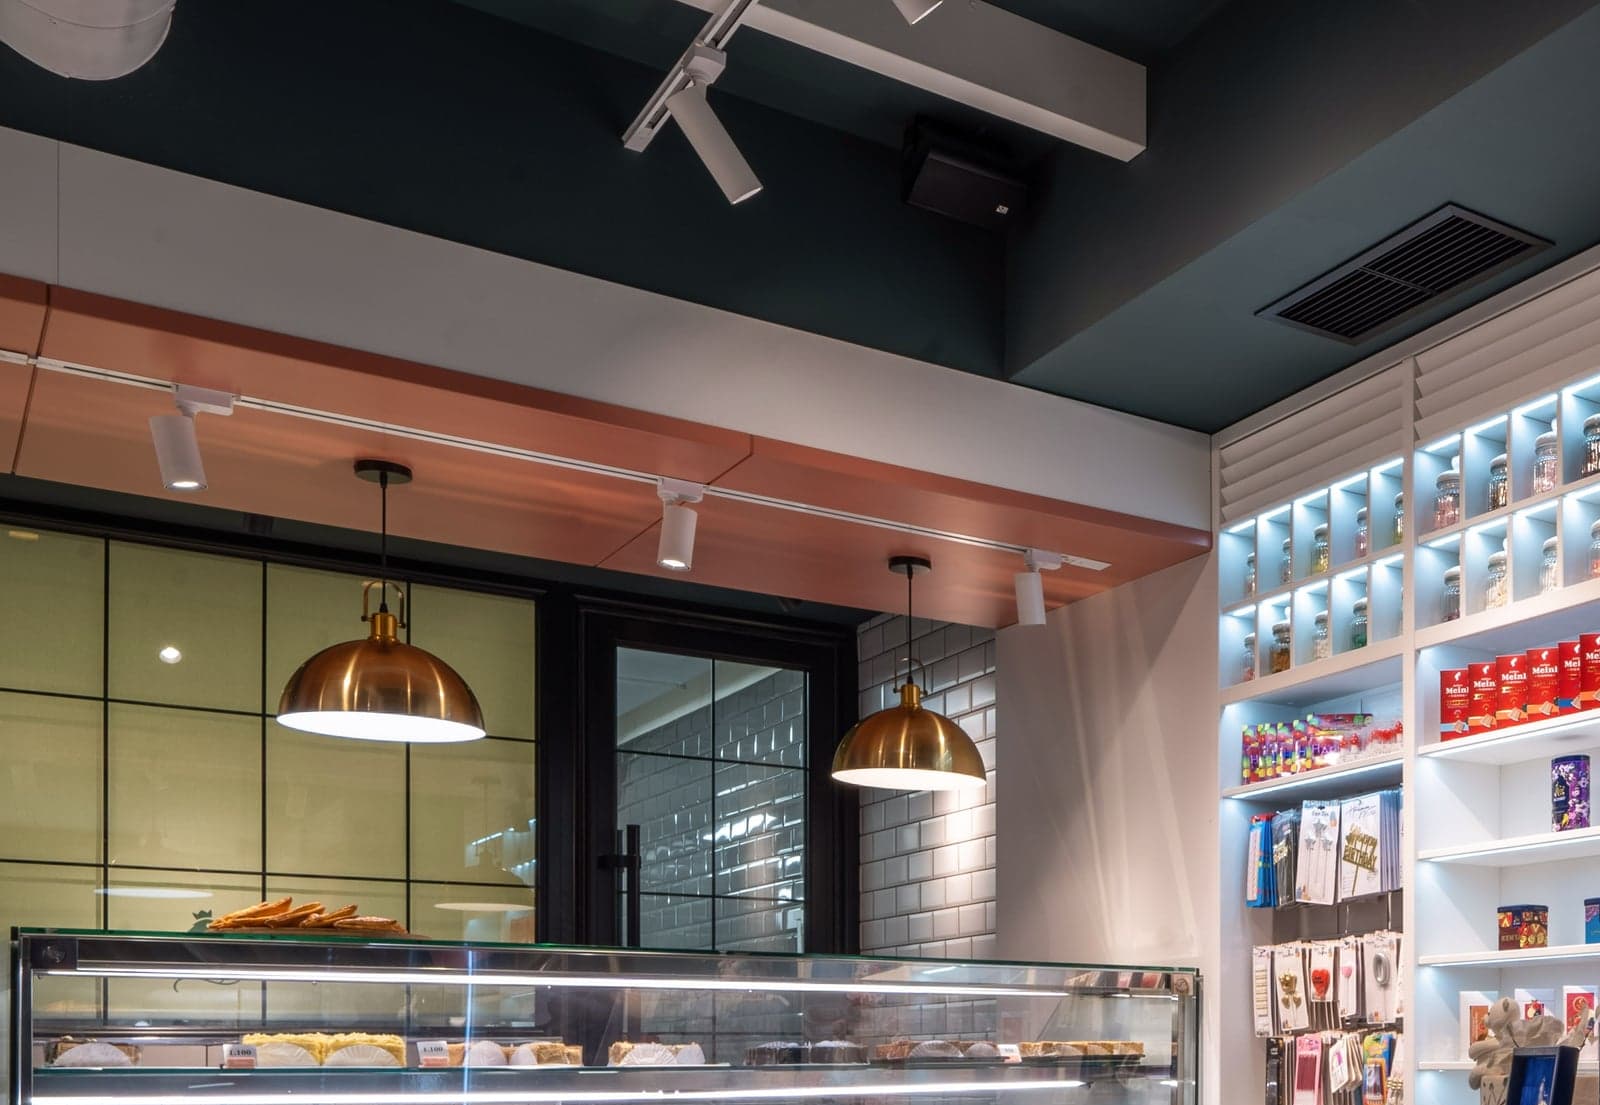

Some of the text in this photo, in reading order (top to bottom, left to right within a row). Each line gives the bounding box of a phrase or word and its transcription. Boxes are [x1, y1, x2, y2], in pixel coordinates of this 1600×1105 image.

[1564, 659, 1580, 668] Mei
[1532, 665, 1558, 675] Meinl
[1473, 680, 1496, 689] Mein
